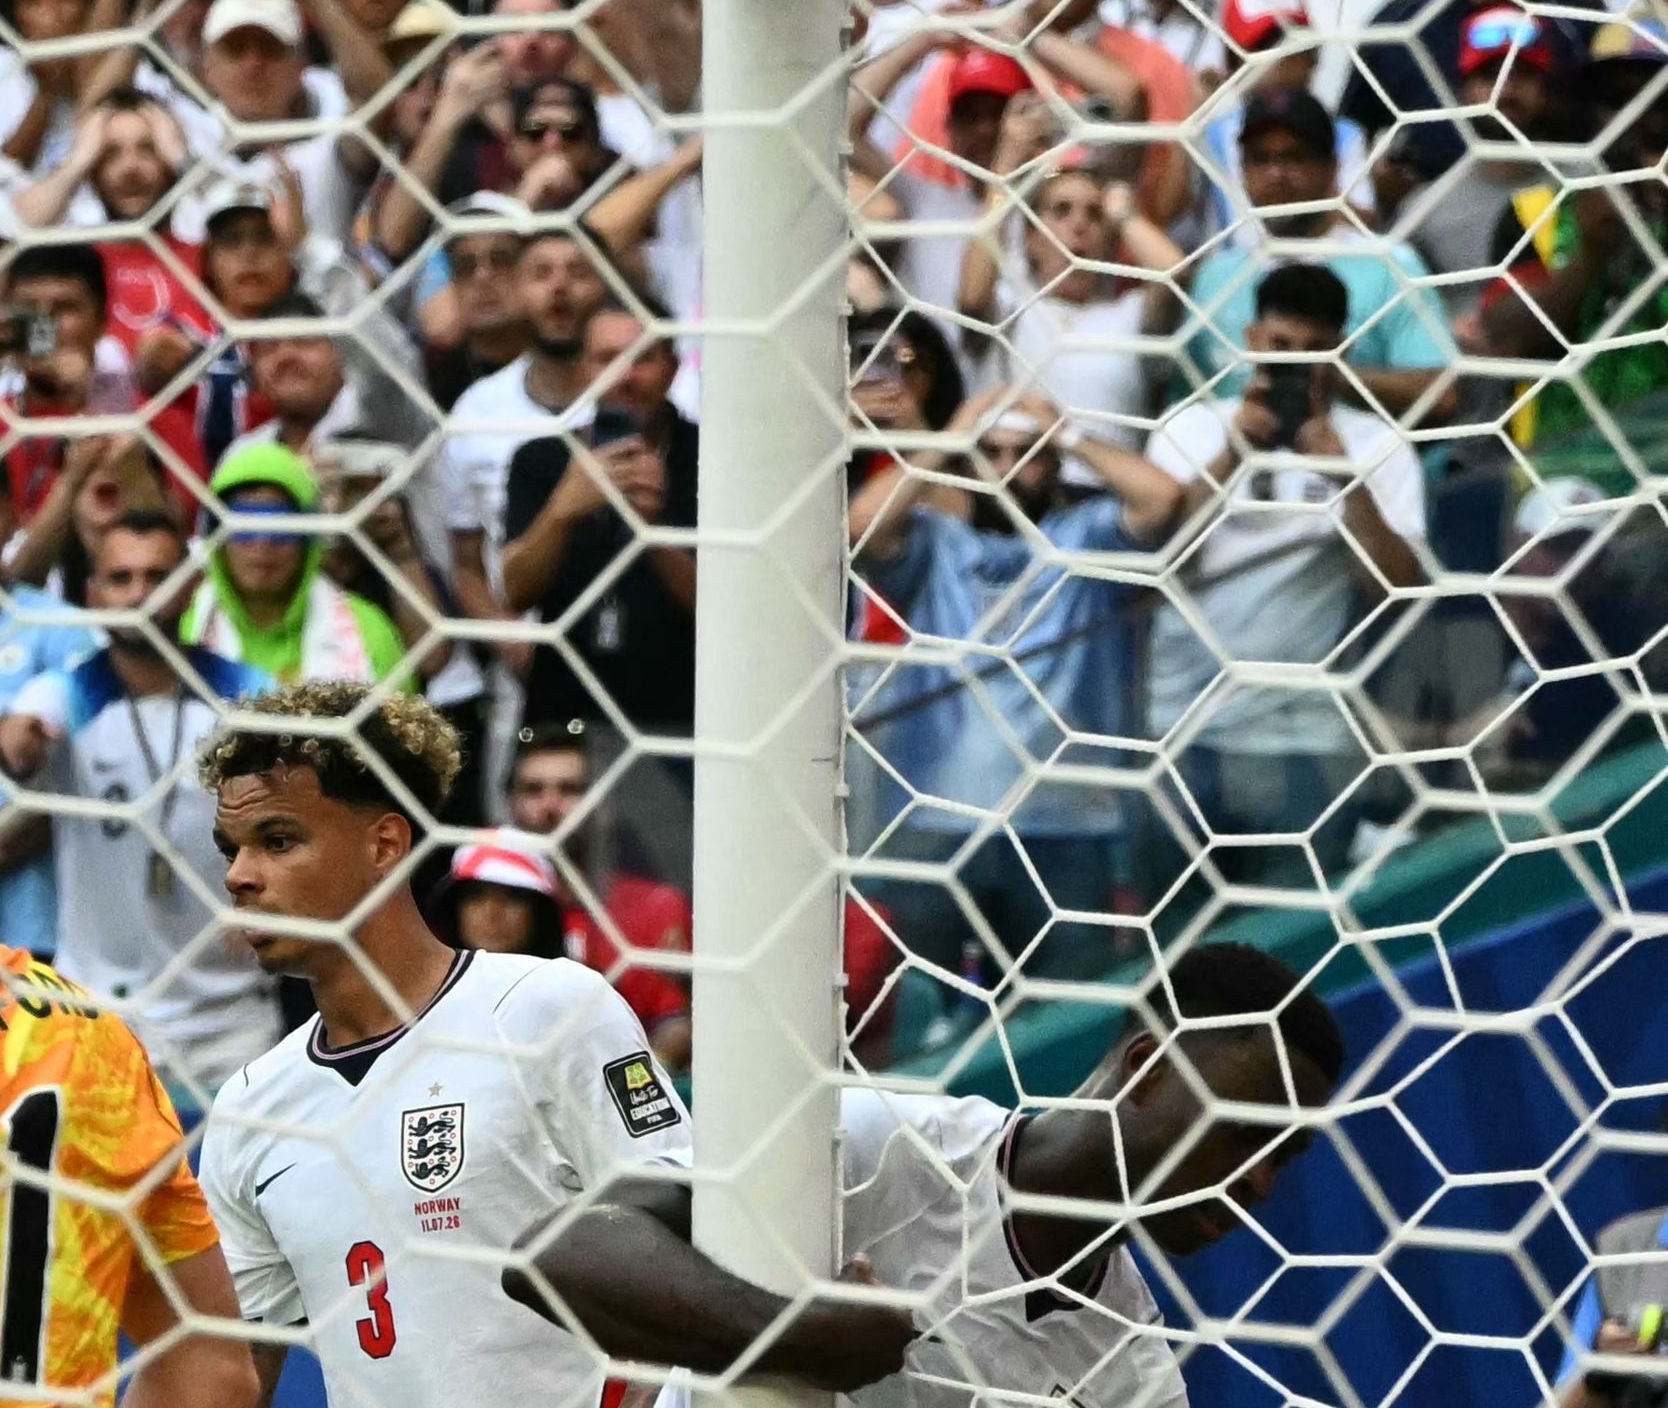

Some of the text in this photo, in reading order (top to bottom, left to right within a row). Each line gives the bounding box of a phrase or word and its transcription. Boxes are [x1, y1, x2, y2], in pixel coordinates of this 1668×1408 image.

[414, 1197, 461, 1216] NORWAY
[421, 1215, 461, 1233] 11.07.26
[346, 1240, 396, 1360] 3
